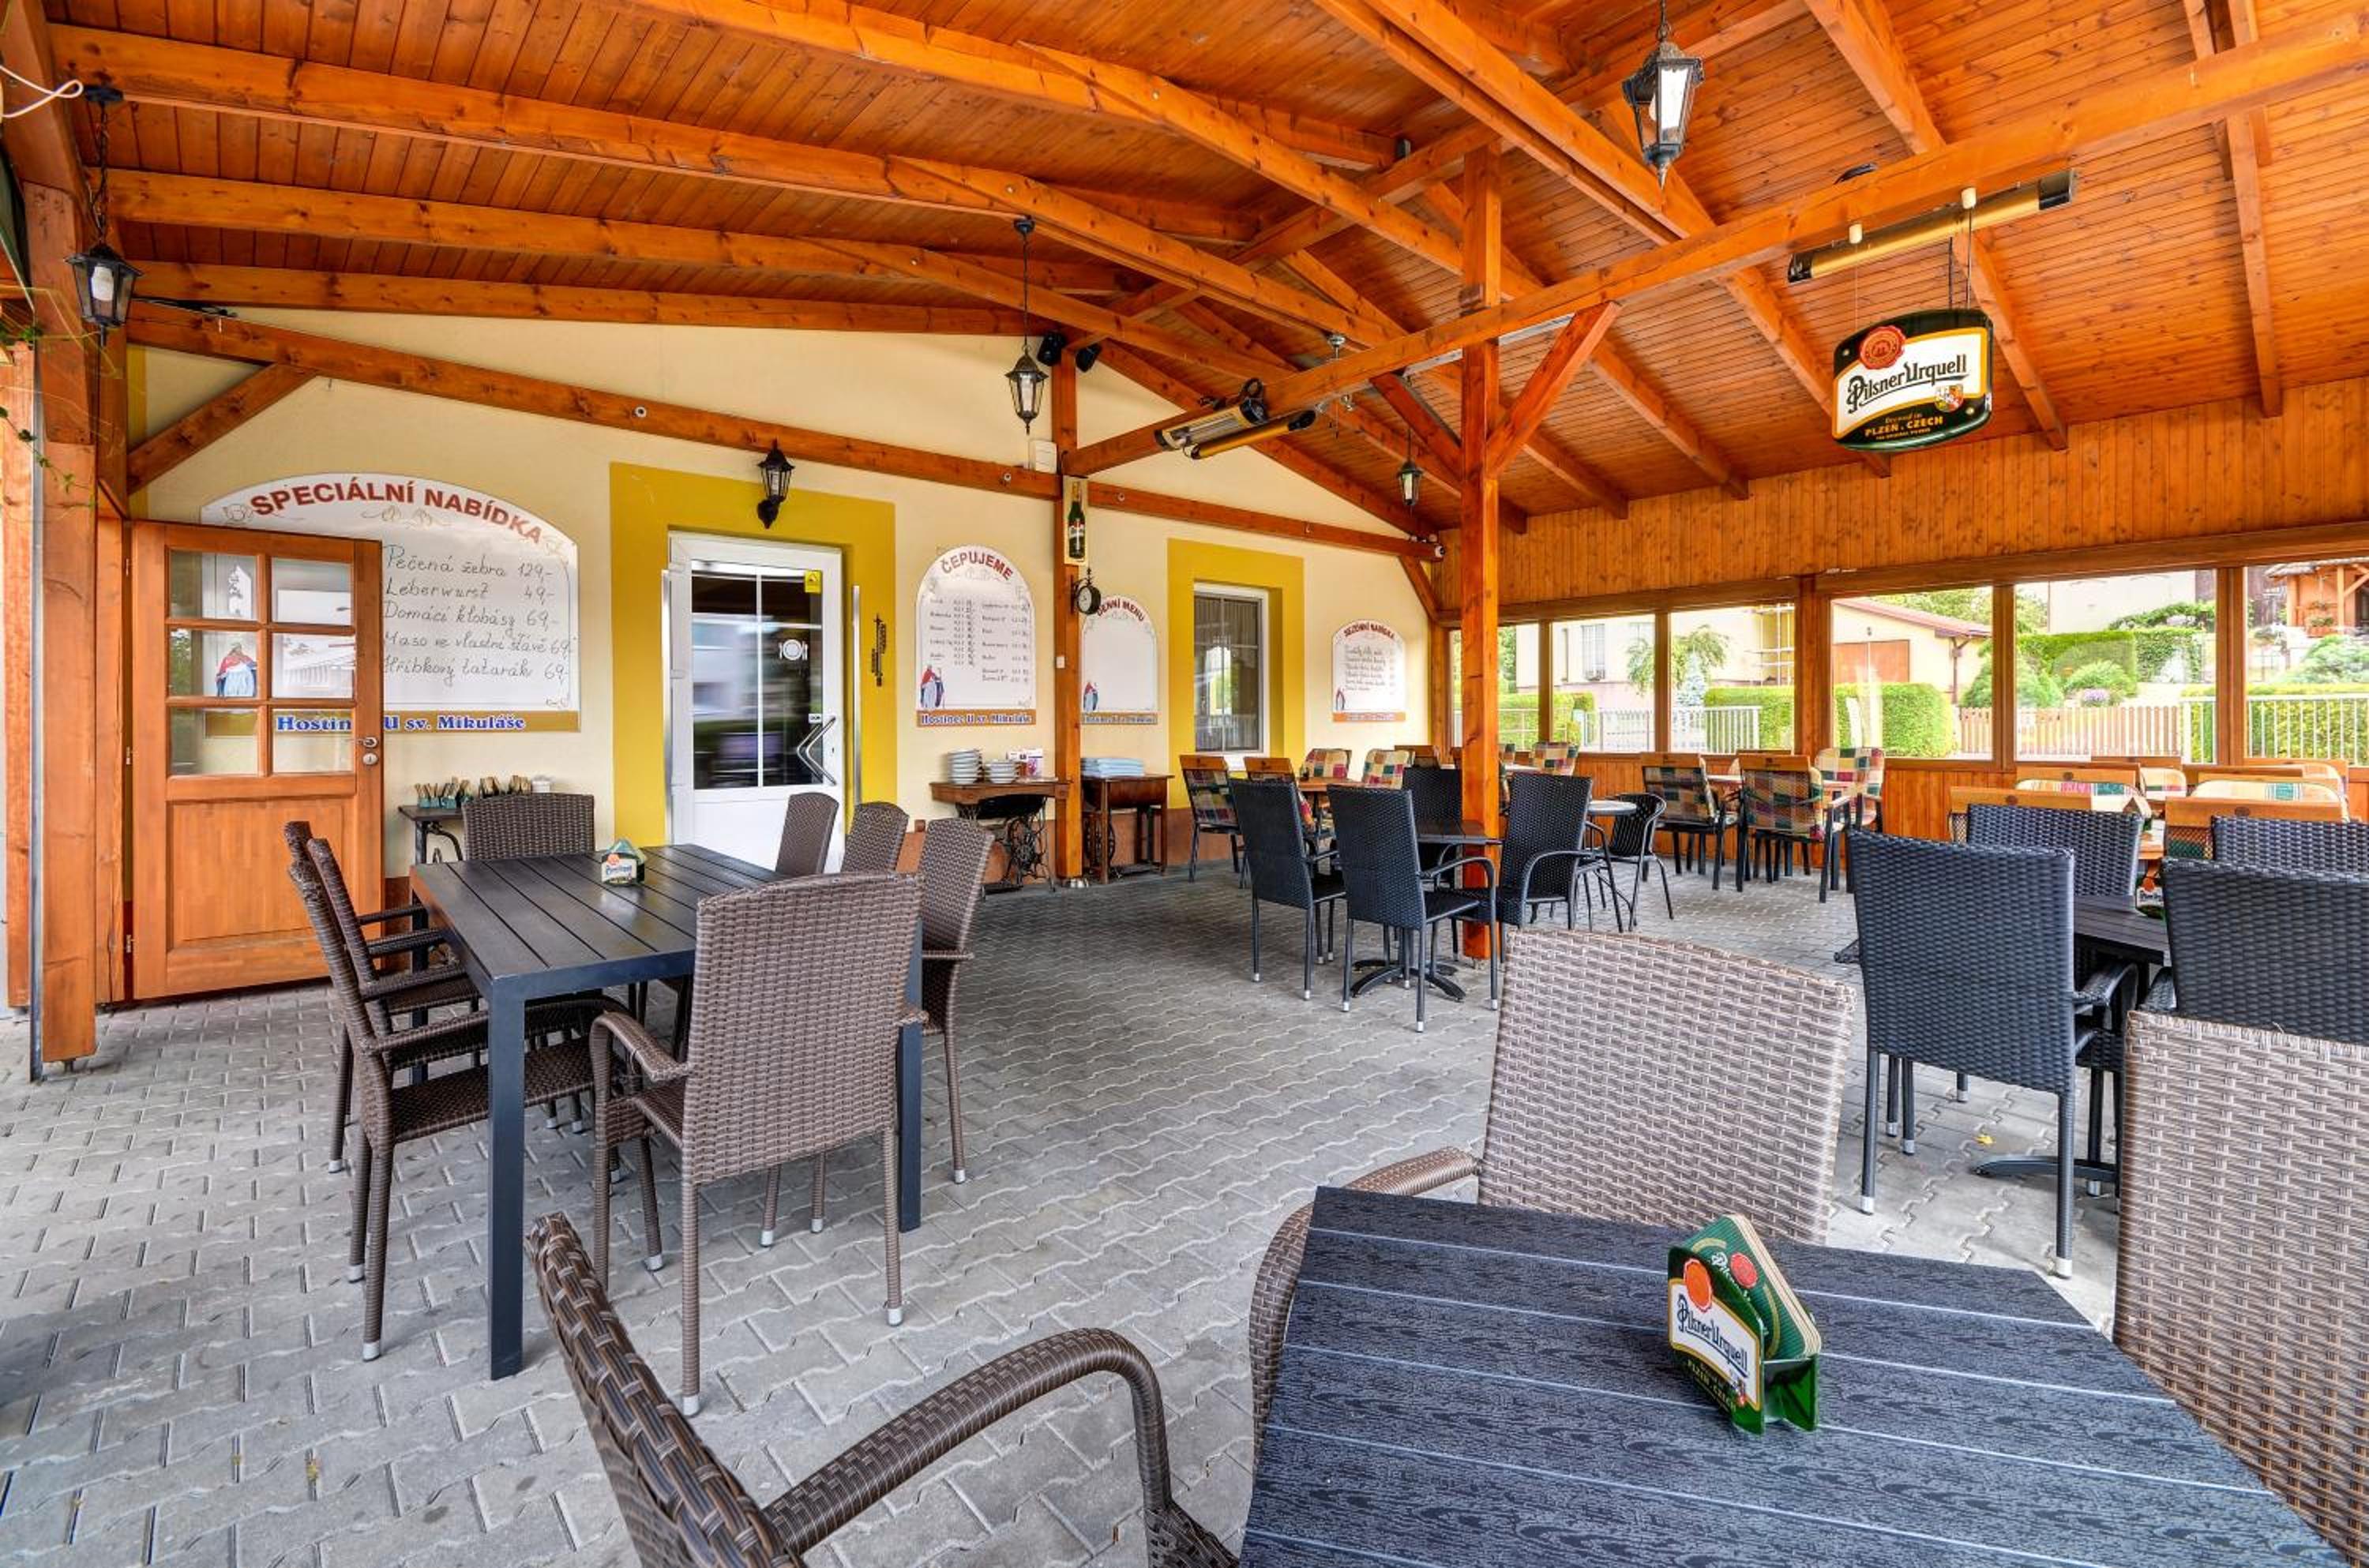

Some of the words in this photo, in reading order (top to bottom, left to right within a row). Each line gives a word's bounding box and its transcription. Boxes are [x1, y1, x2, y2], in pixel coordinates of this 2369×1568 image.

[1846, 373, 1905, 415] Pilsner
[1903, 353, 1967, 387] Urquell
[250, 476, 415, 516] SPECIÁLNÍ
[424, 488, 543, 545] NABÍDKA
[941, 551, 1013, 580] ČEPUJEME
[1122, 600, 1144, 621] MENU
[277, 715, 352, 730] Hostin
[384, 716, 399, 730] U
[405, 719, 431, 730] sv.
[437, 714, 525, 730] Mikuláše
[1677, 1293, 1712, 1340] Pilsner
[1710, 1319, 1747, 1372] Urquell
